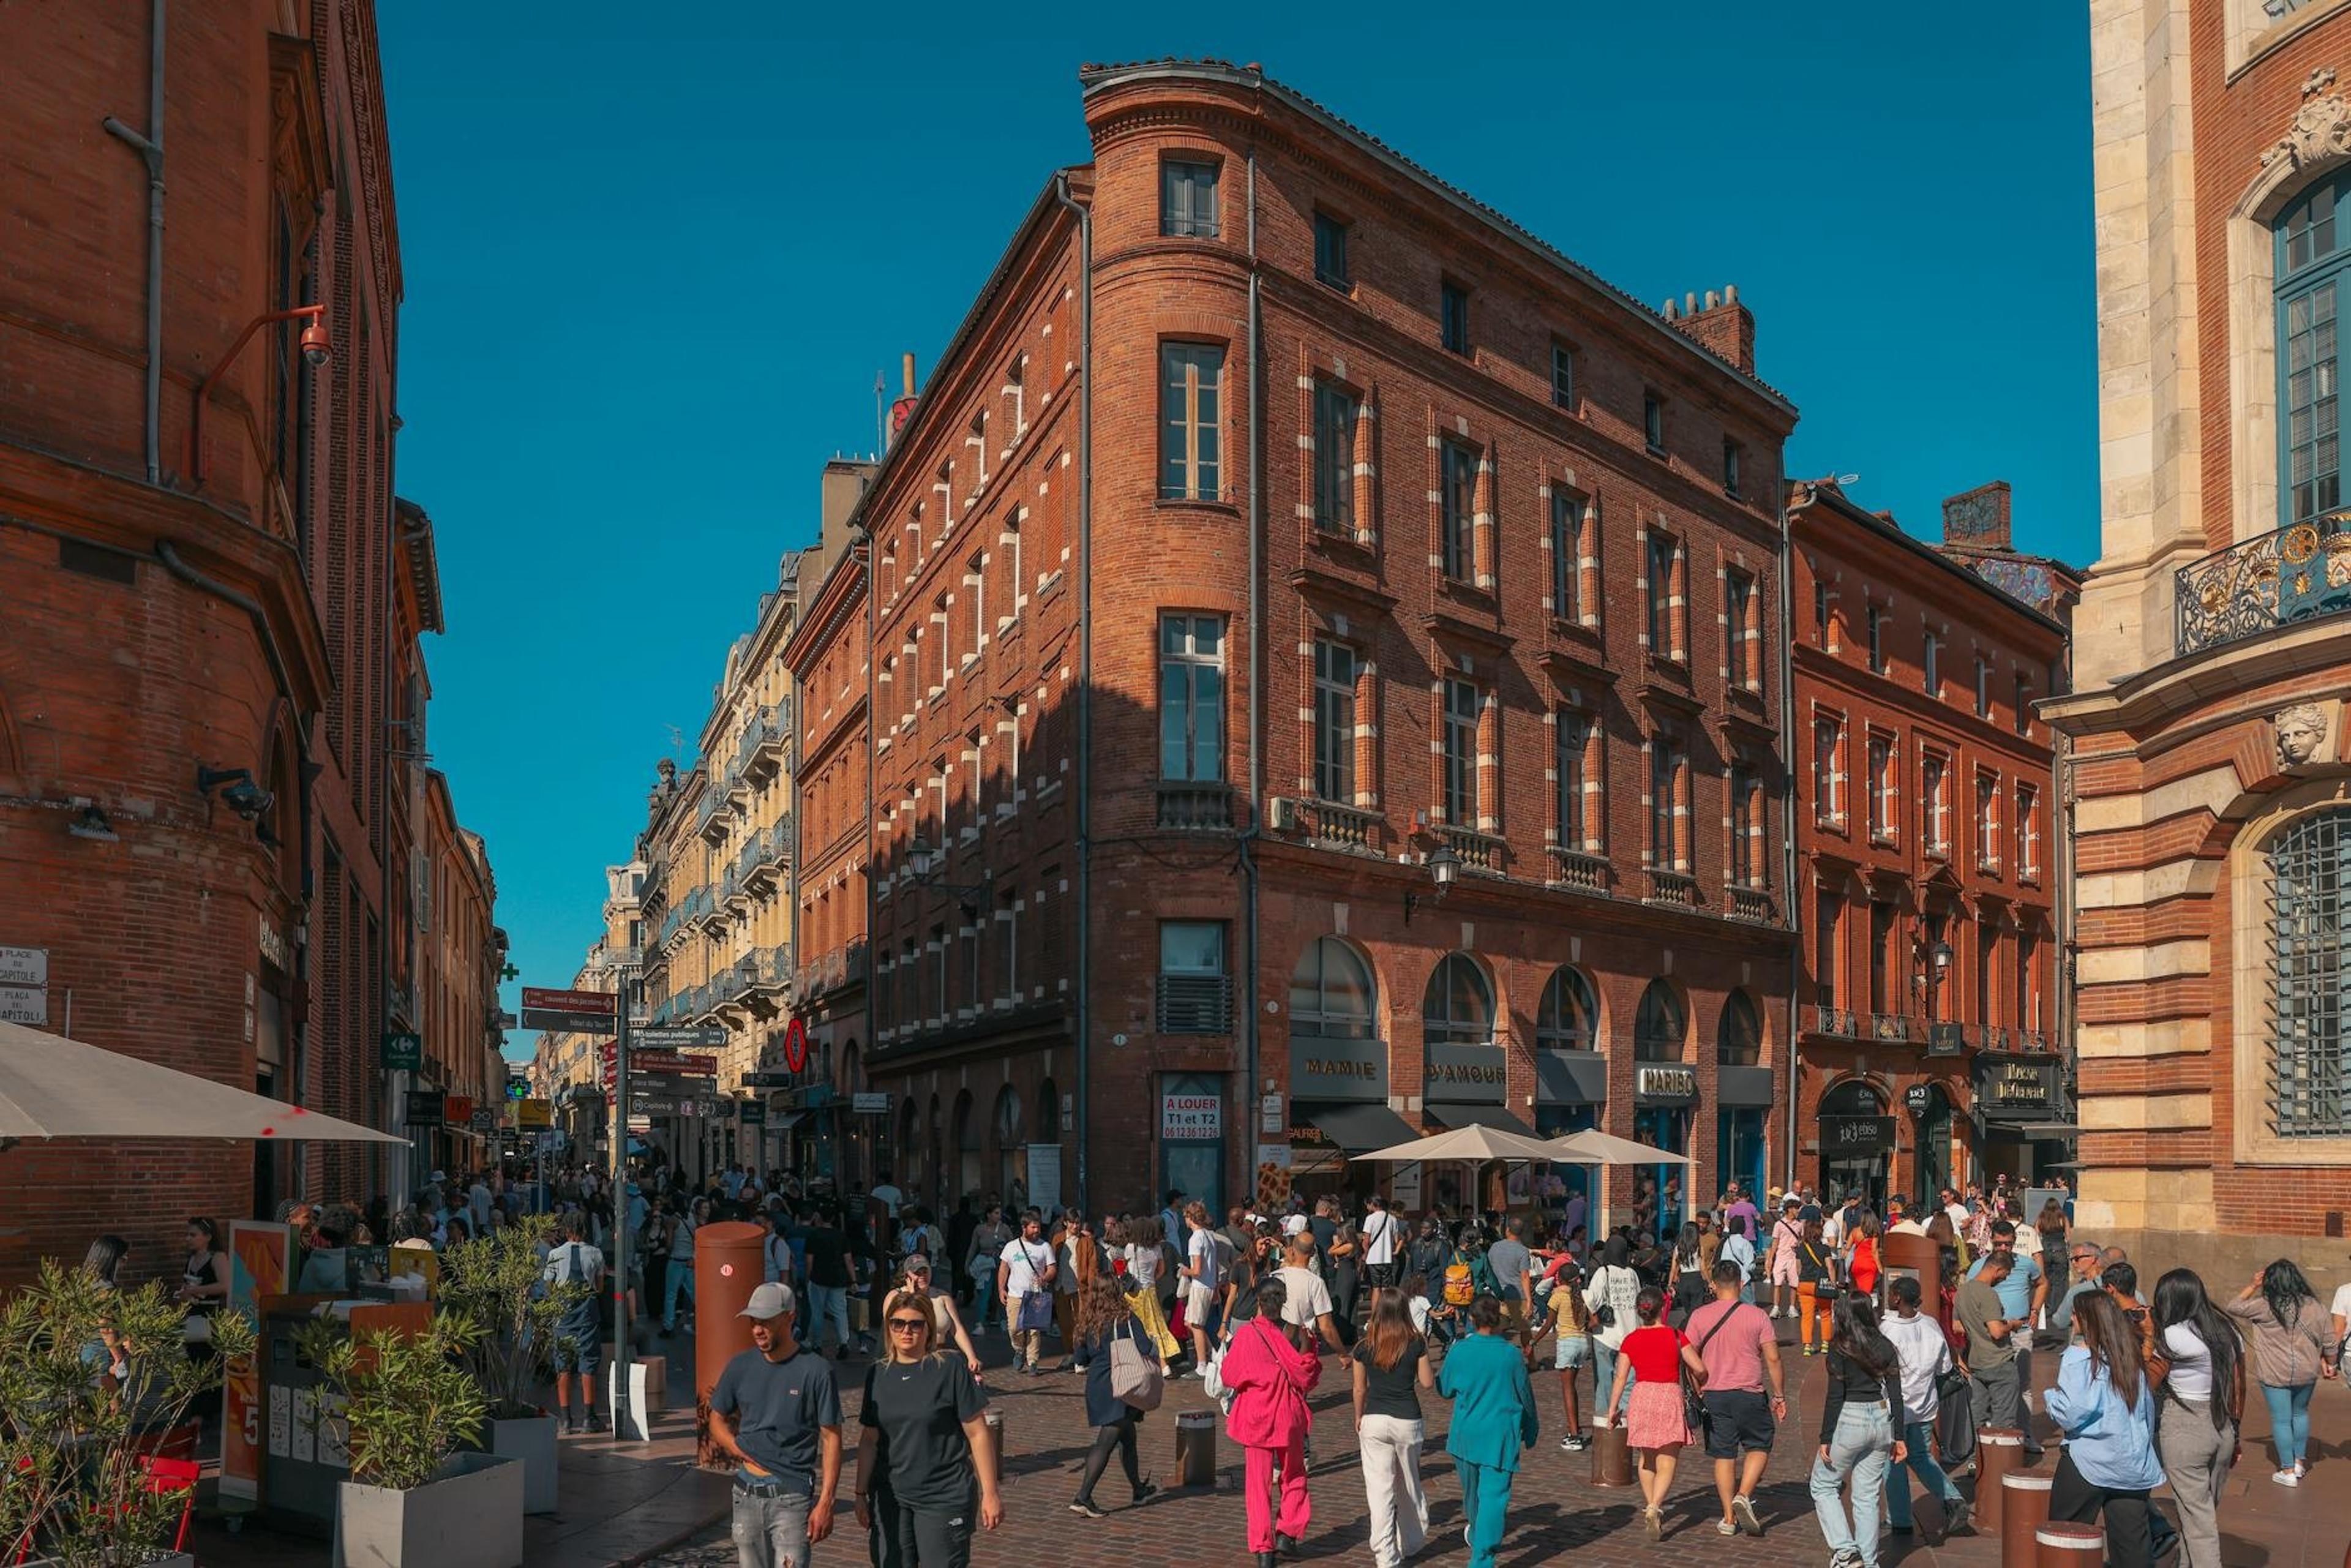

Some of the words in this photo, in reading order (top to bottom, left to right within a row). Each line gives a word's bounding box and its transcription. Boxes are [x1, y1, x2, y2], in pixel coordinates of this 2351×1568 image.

[6, 950, 32, 959] PLACE
[1306, 1059, 1376, 1078] MAMIE
[1425, 1061, 1506, 1082] D'AMOUR
[1641, 1069, 1694, 1096] HARIBO
[1179, 1098, 1217, 1109] LOUER
[1168, 1113, 1181, 1125] T1
[1185, 1114, 1196, 1125] et
[1201, 1113, 1215, 1124] T2
